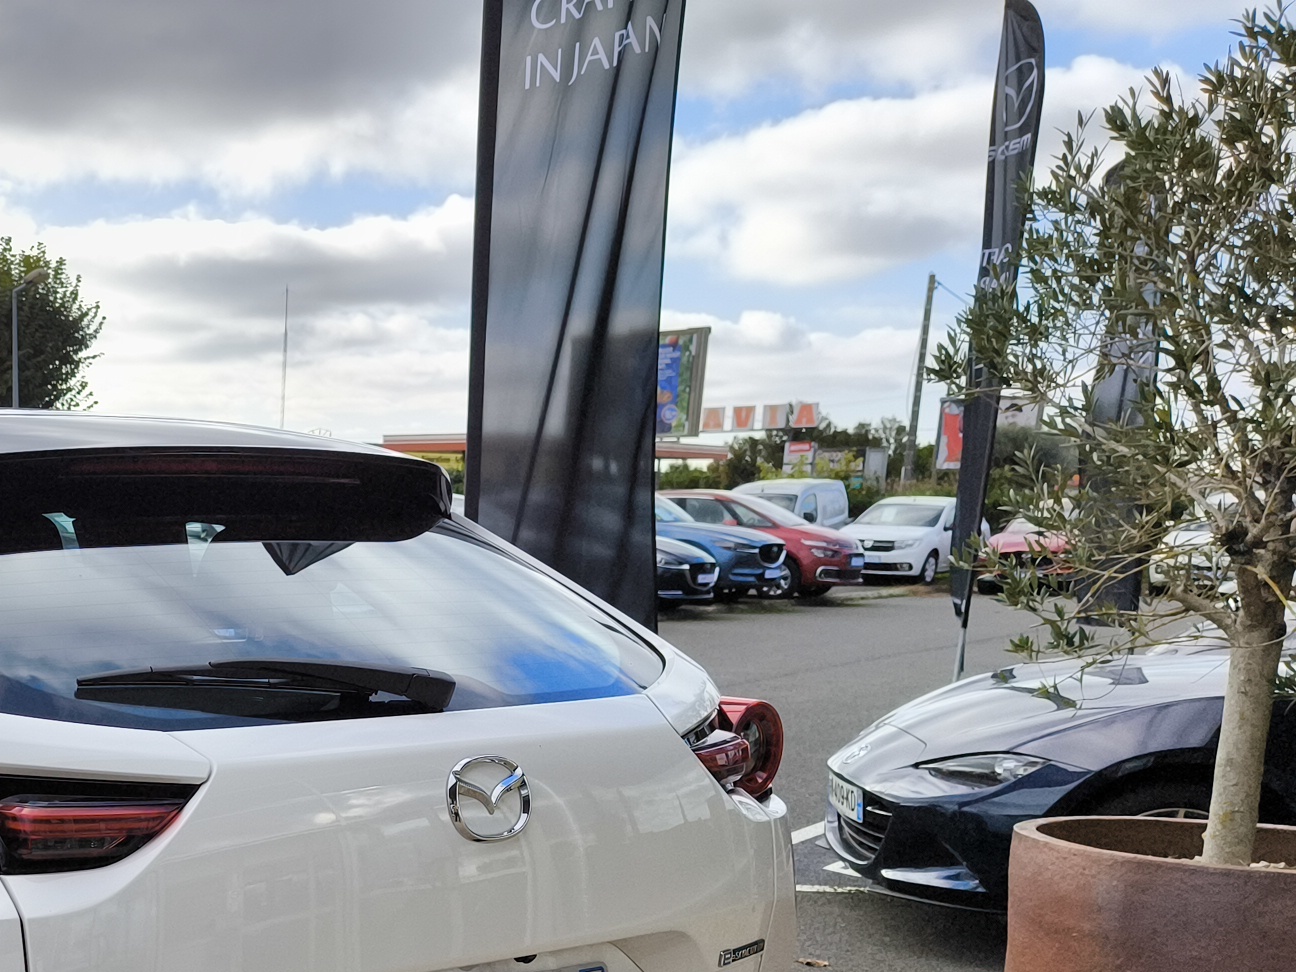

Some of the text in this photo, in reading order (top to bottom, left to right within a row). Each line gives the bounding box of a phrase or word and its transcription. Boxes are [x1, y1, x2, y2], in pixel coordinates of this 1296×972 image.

[525, 13, 667, 90] IN JAPAN
[703, 404, 817, 429] AVIA
